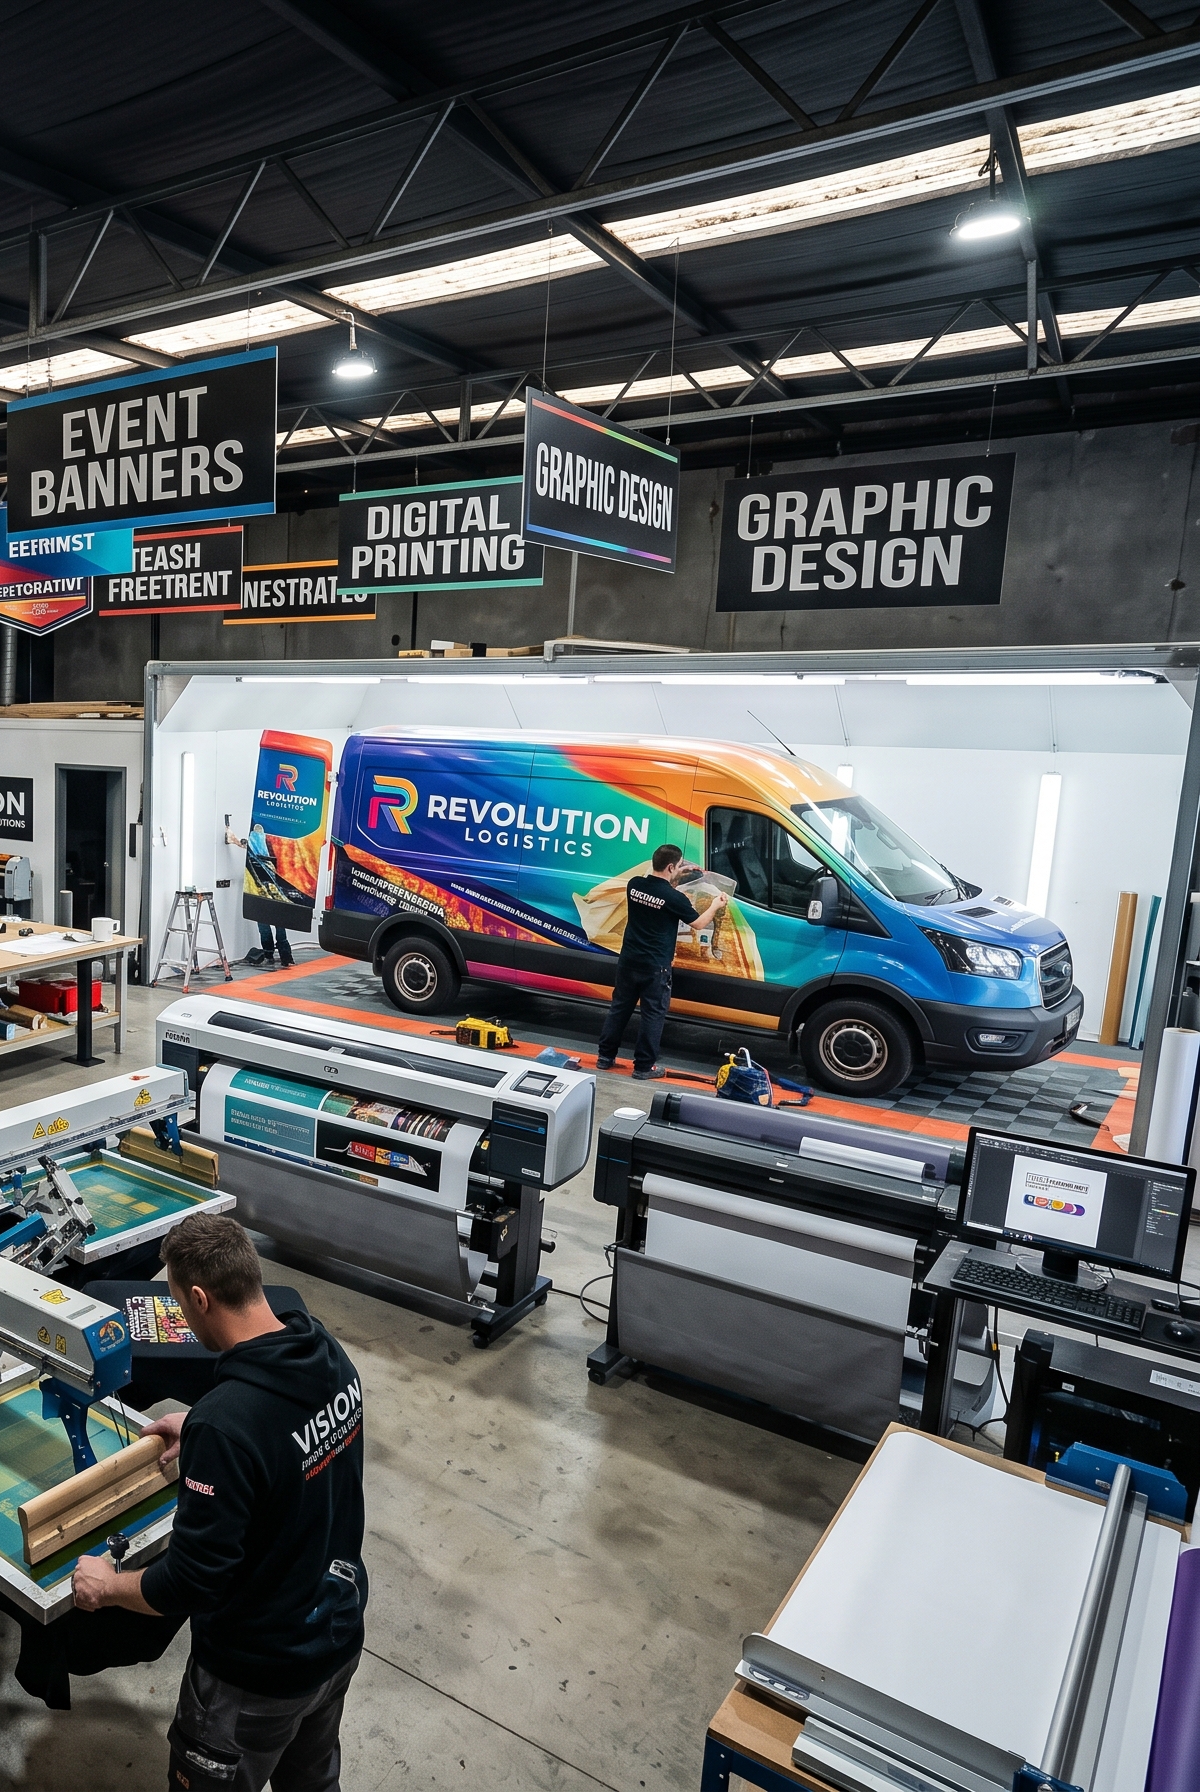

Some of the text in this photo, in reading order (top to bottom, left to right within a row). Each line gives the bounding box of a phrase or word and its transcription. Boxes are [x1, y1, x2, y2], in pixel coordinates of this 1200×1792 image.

[61, 386, 208, 460] EVENT
[30, 440, 244, 518] BANNERS
[535, 441, 672, 533] GRAPHIC DESIGN
[367, 494, 510, 541] DIGITAL
[737, 474, 994, 542] GRAPHIC
[352, 533, 525, 580] PRINTING
[750, 534, 964, 594] DESIGN
[108, 570, 233, 603] FREETRENT
[257, 790, 318, 807] REVOLUTION
[427, 795, 650, 844] REVOLUTION
[465, 828, 593, 857] LOGISTICS
[291, 1377, 362, 1455] VISION
